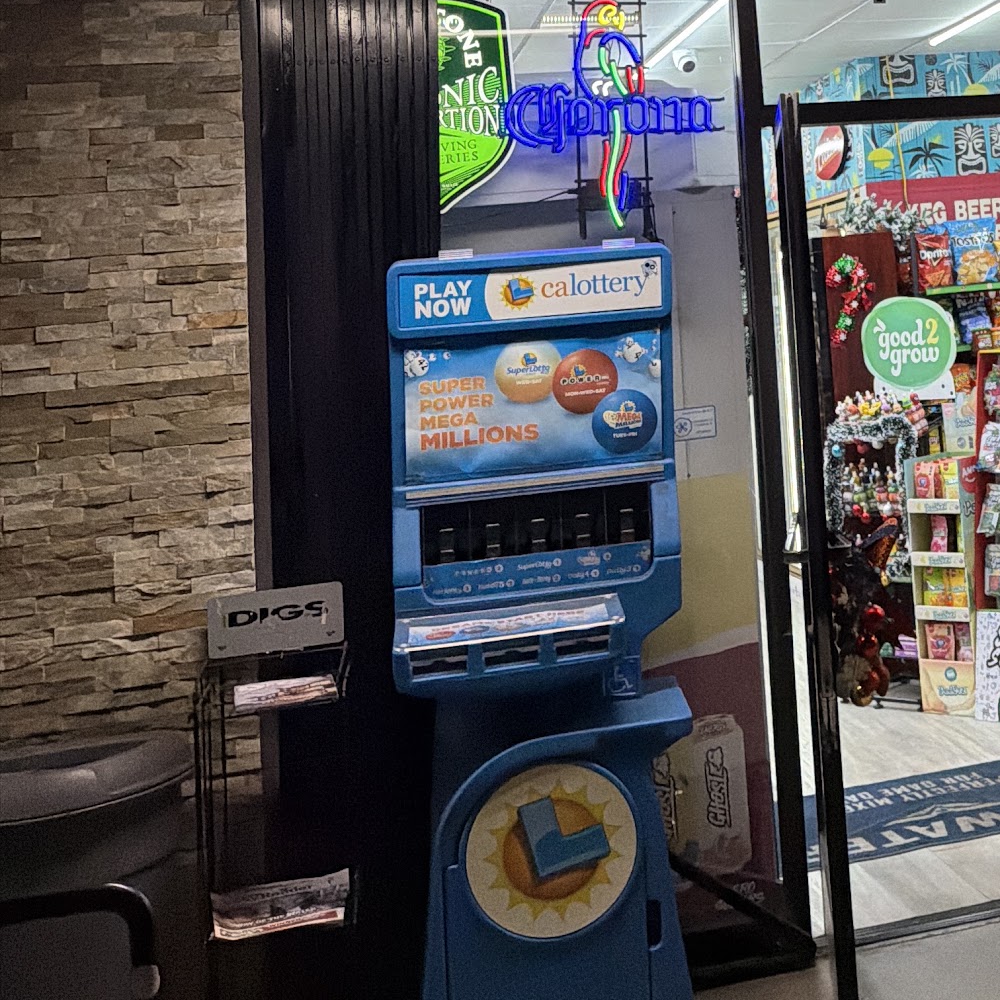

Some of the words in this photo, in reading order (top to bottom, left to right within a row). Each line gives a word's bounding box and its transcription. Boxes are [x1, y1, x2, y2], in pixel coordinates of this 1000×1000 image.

[504, 82, 714, 153] Corona
[414, 279, 473, 300] PLAY
[540, 272, 647, 298] calottery
[414, 297, 472, 320] NOW
[890, 346, 940, 377] grow
[418, 376, 486, 396] SUPER
[419, 393, 495, 413] POWER
[419, 411, 479, 432] MEGA
[420, 423, 540, 451] MILLIONS
